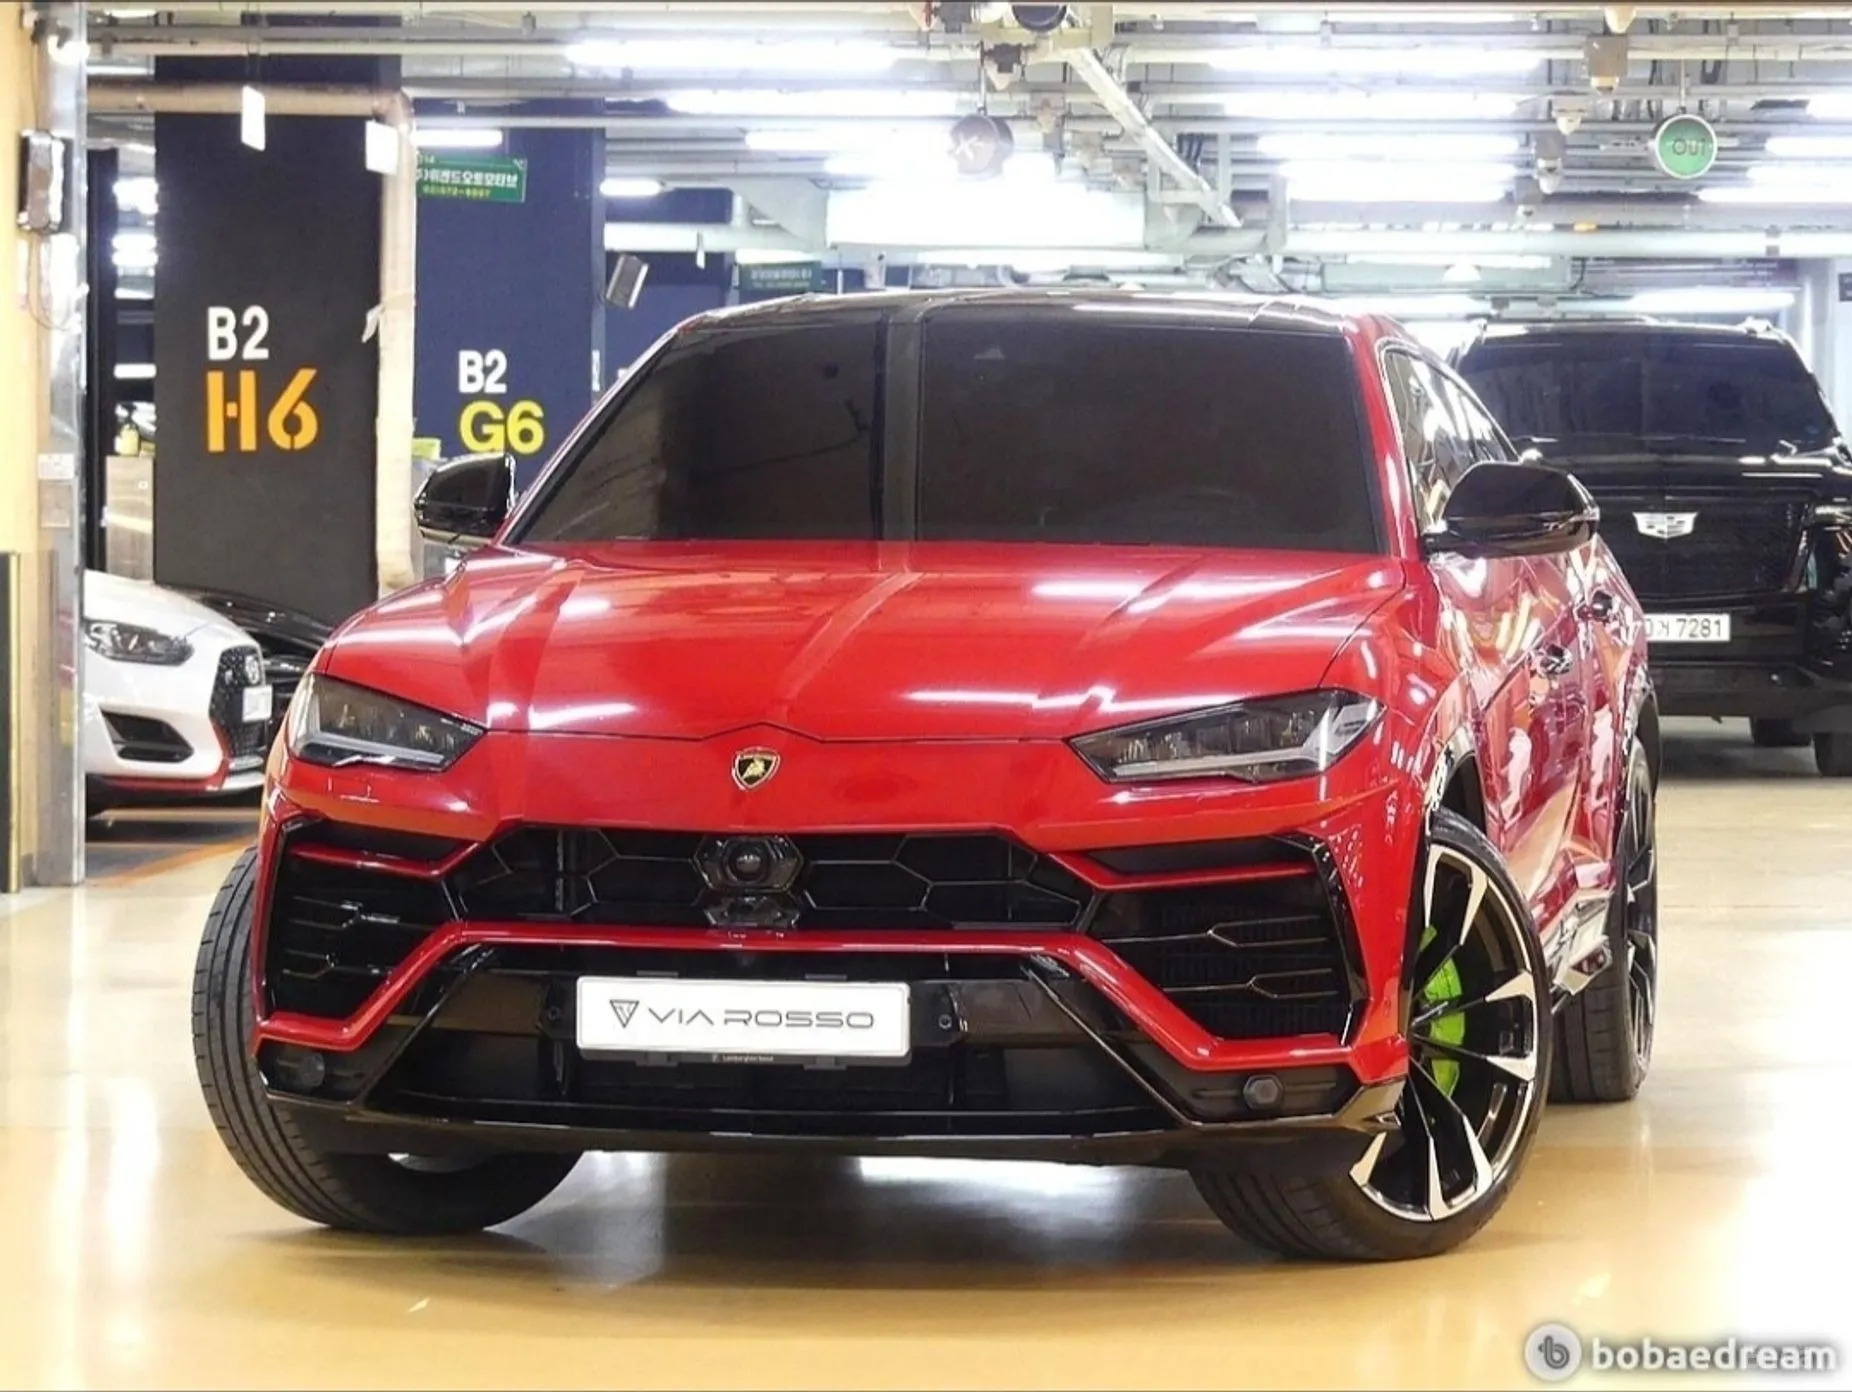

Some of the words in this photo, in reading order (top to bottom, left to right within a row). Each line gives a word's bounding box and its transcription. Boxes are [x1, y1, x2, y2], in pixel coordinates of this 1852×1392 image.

[207, 306, 269, 360] B2
[459, 350, 507, 393] B2
[207, 368, 318, 451] H6
[460, 400, 544, 453] G6
[1676, 618, 1721, 637] 7281
[648, 1008, 714, 1026] VIA
[723, 1009, 874, 1029] ROSSO
